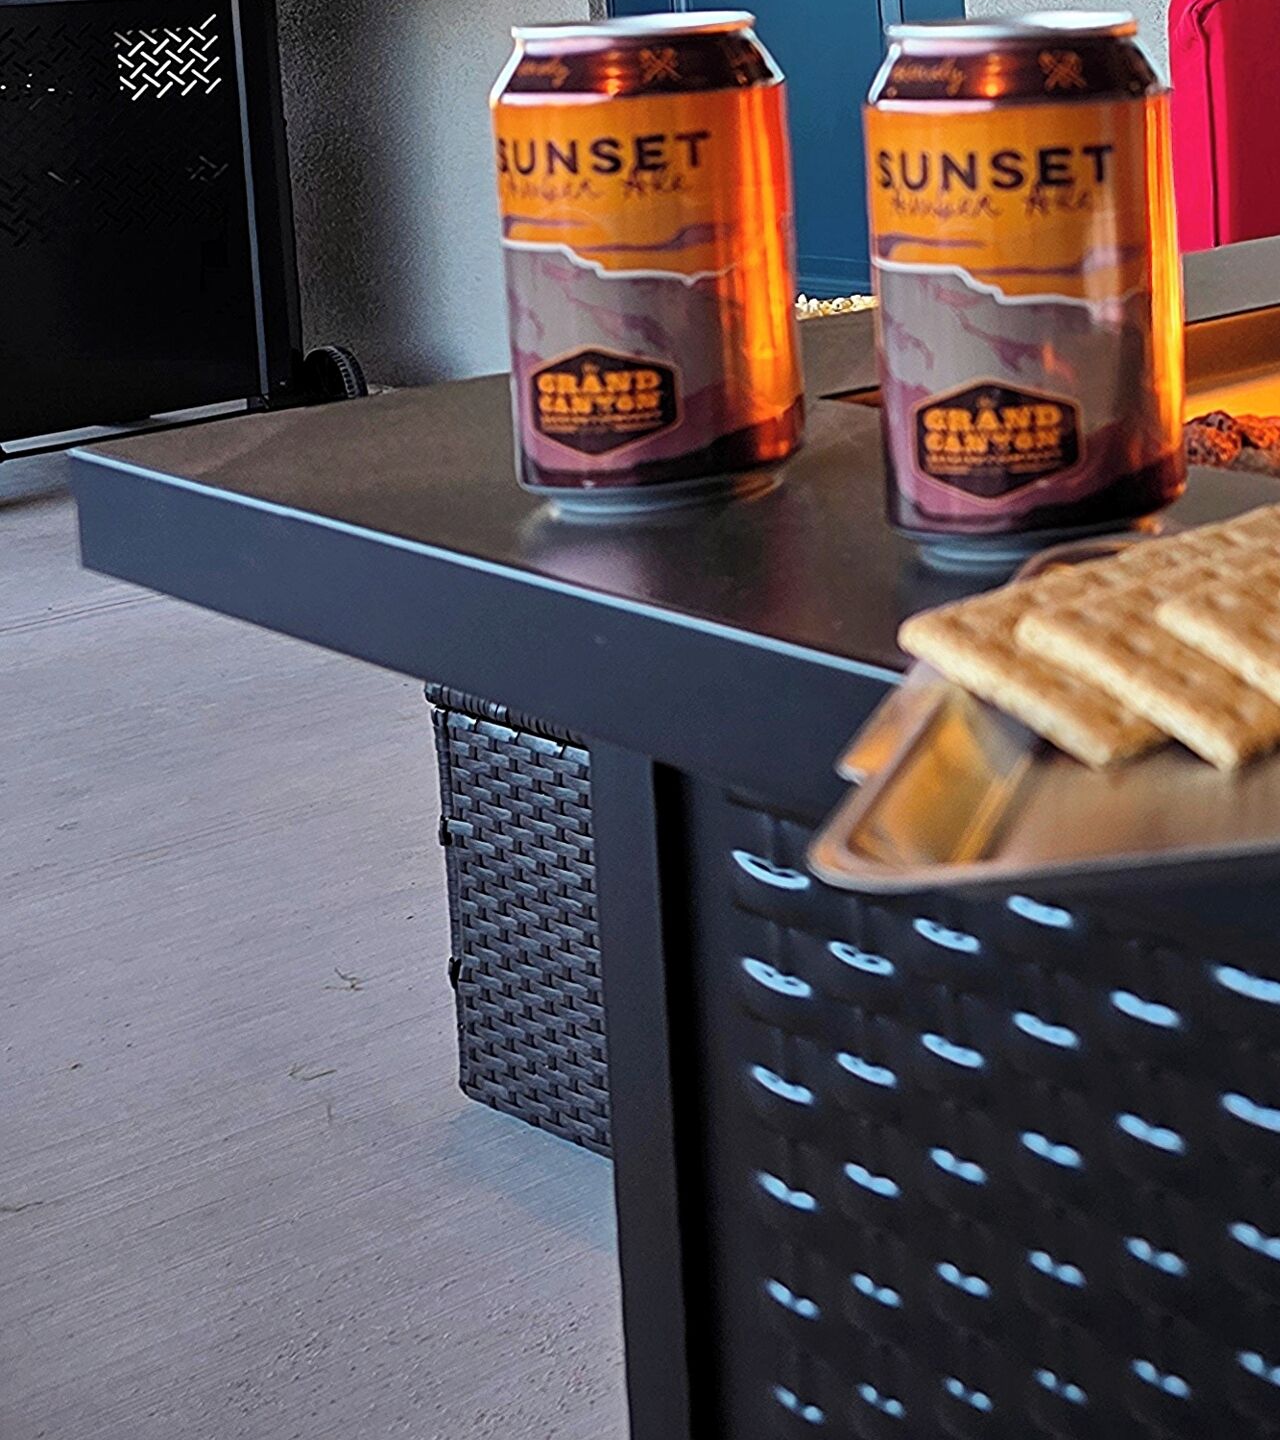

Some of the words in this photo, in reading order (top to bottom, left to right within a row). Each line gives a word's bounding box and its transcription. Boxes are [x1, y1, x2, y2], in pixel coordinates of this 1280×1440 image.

[498, 129, 711, 175] SUNSET
[876, 143, 1114, 191] SUNSET
[537, 369, 662, 395] GRAND
[538, 390, 662, 414] CANYON
[923, 403, 1063, 432] GRAND
[924, 427, 1062, 453] CANYON
